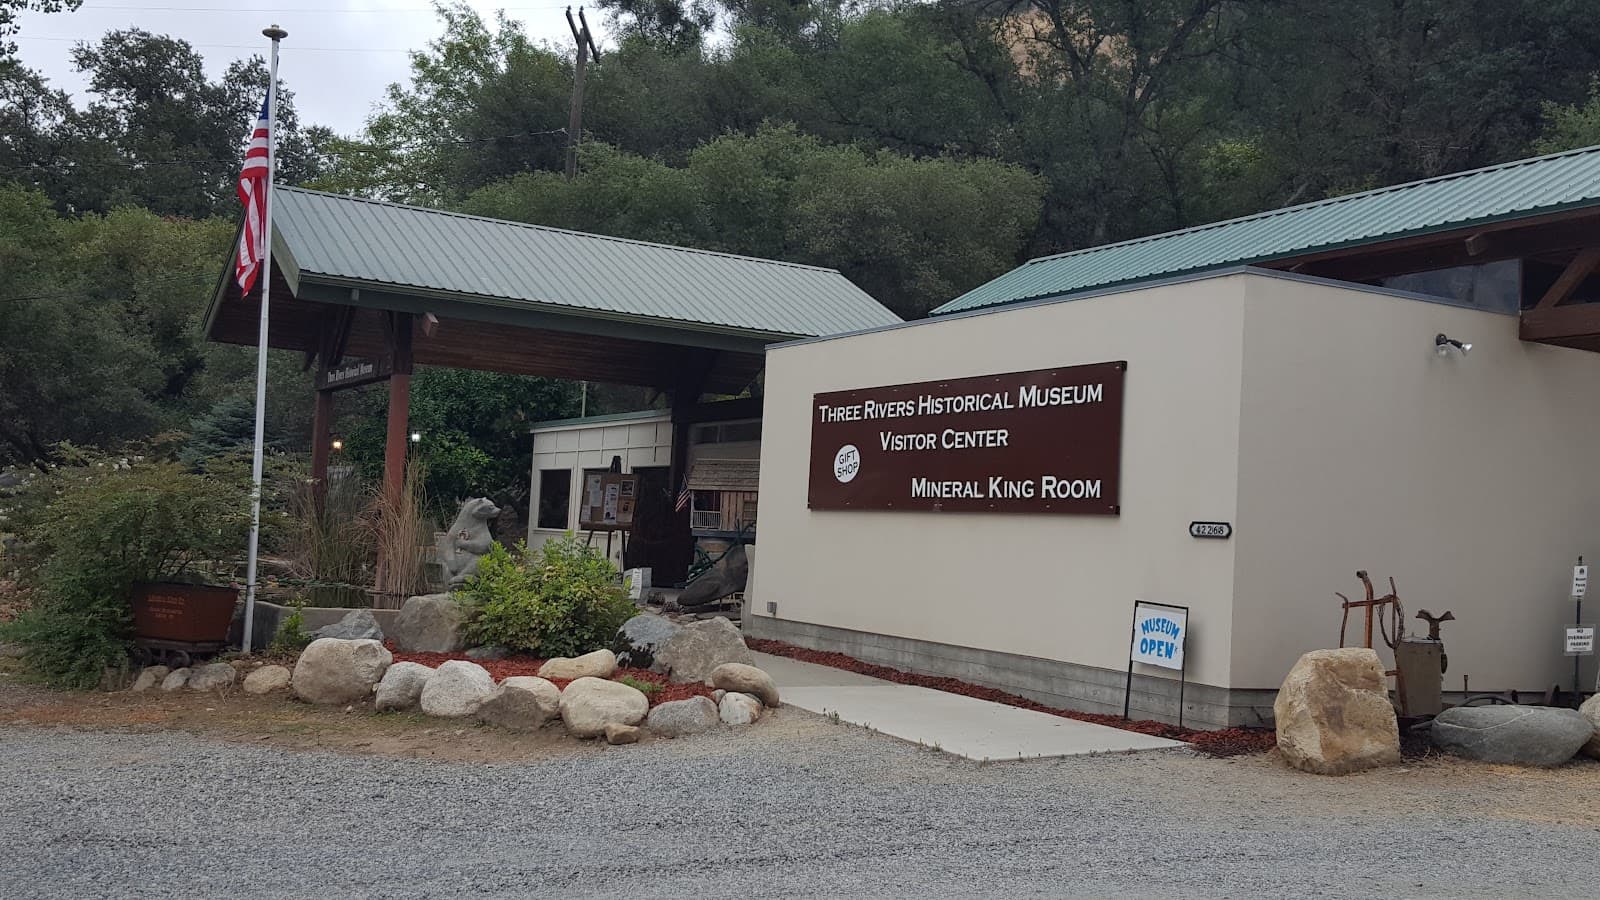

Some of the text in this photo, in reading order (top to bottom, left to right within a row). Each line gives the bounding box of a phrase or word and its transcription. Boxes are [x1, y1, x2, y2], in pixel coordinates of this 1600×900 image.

[819, 383, 1103, 422] THREE RIVERS HISTORICAL MUSEUM
[880, 429, 1009, 451] VISITOR CENTER
[839, 449, 856, 464] GIFT
[837, 462, 858, 478] SHOP
[911, 476, 1102, 499] MINERAL KING ROOM
[1196, 525, 1224, 535] 42268
[1141, 618, 1180, 640] MUSEUM
[1140, 638, 1175, 660] OPEN
